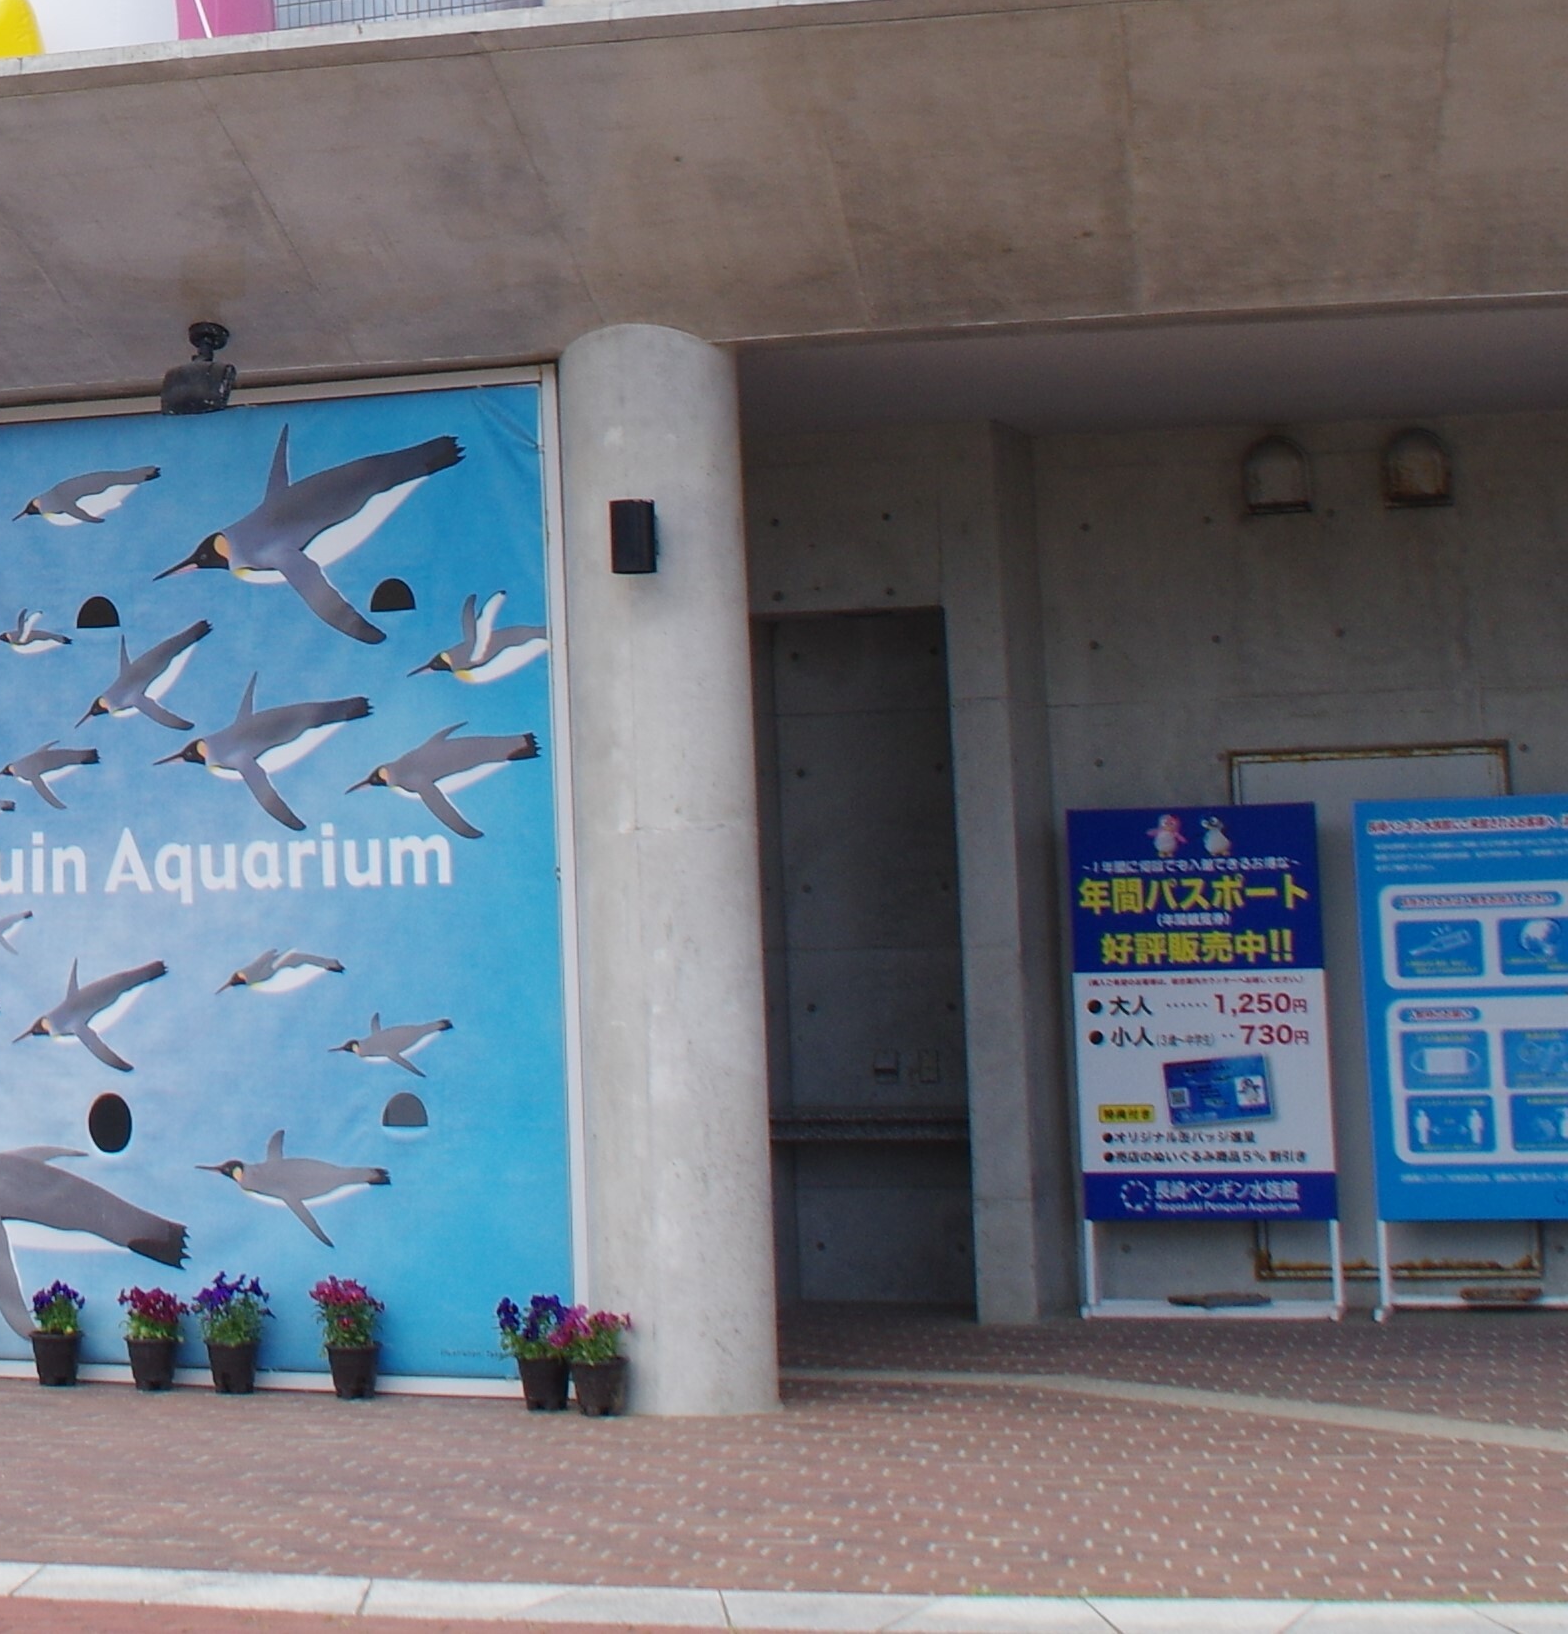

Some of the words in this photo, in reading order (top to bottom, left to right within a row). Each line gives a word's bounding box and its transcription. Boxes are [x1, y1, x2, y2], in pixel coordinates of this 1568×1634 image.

[103, 822, 454, 907] Aquarium
[1078, 873, 1309, 915] 年間パスポート
[1100, 928, 1294, 965] 好評販売中!!
[1108, 994, 1153, 1017] 大人
[1213, 992, 1308, 1017] 1,250円
[1110, 1025, 1154, 1047] 小人
[1239, 1023, 1310, 1047] 730円
